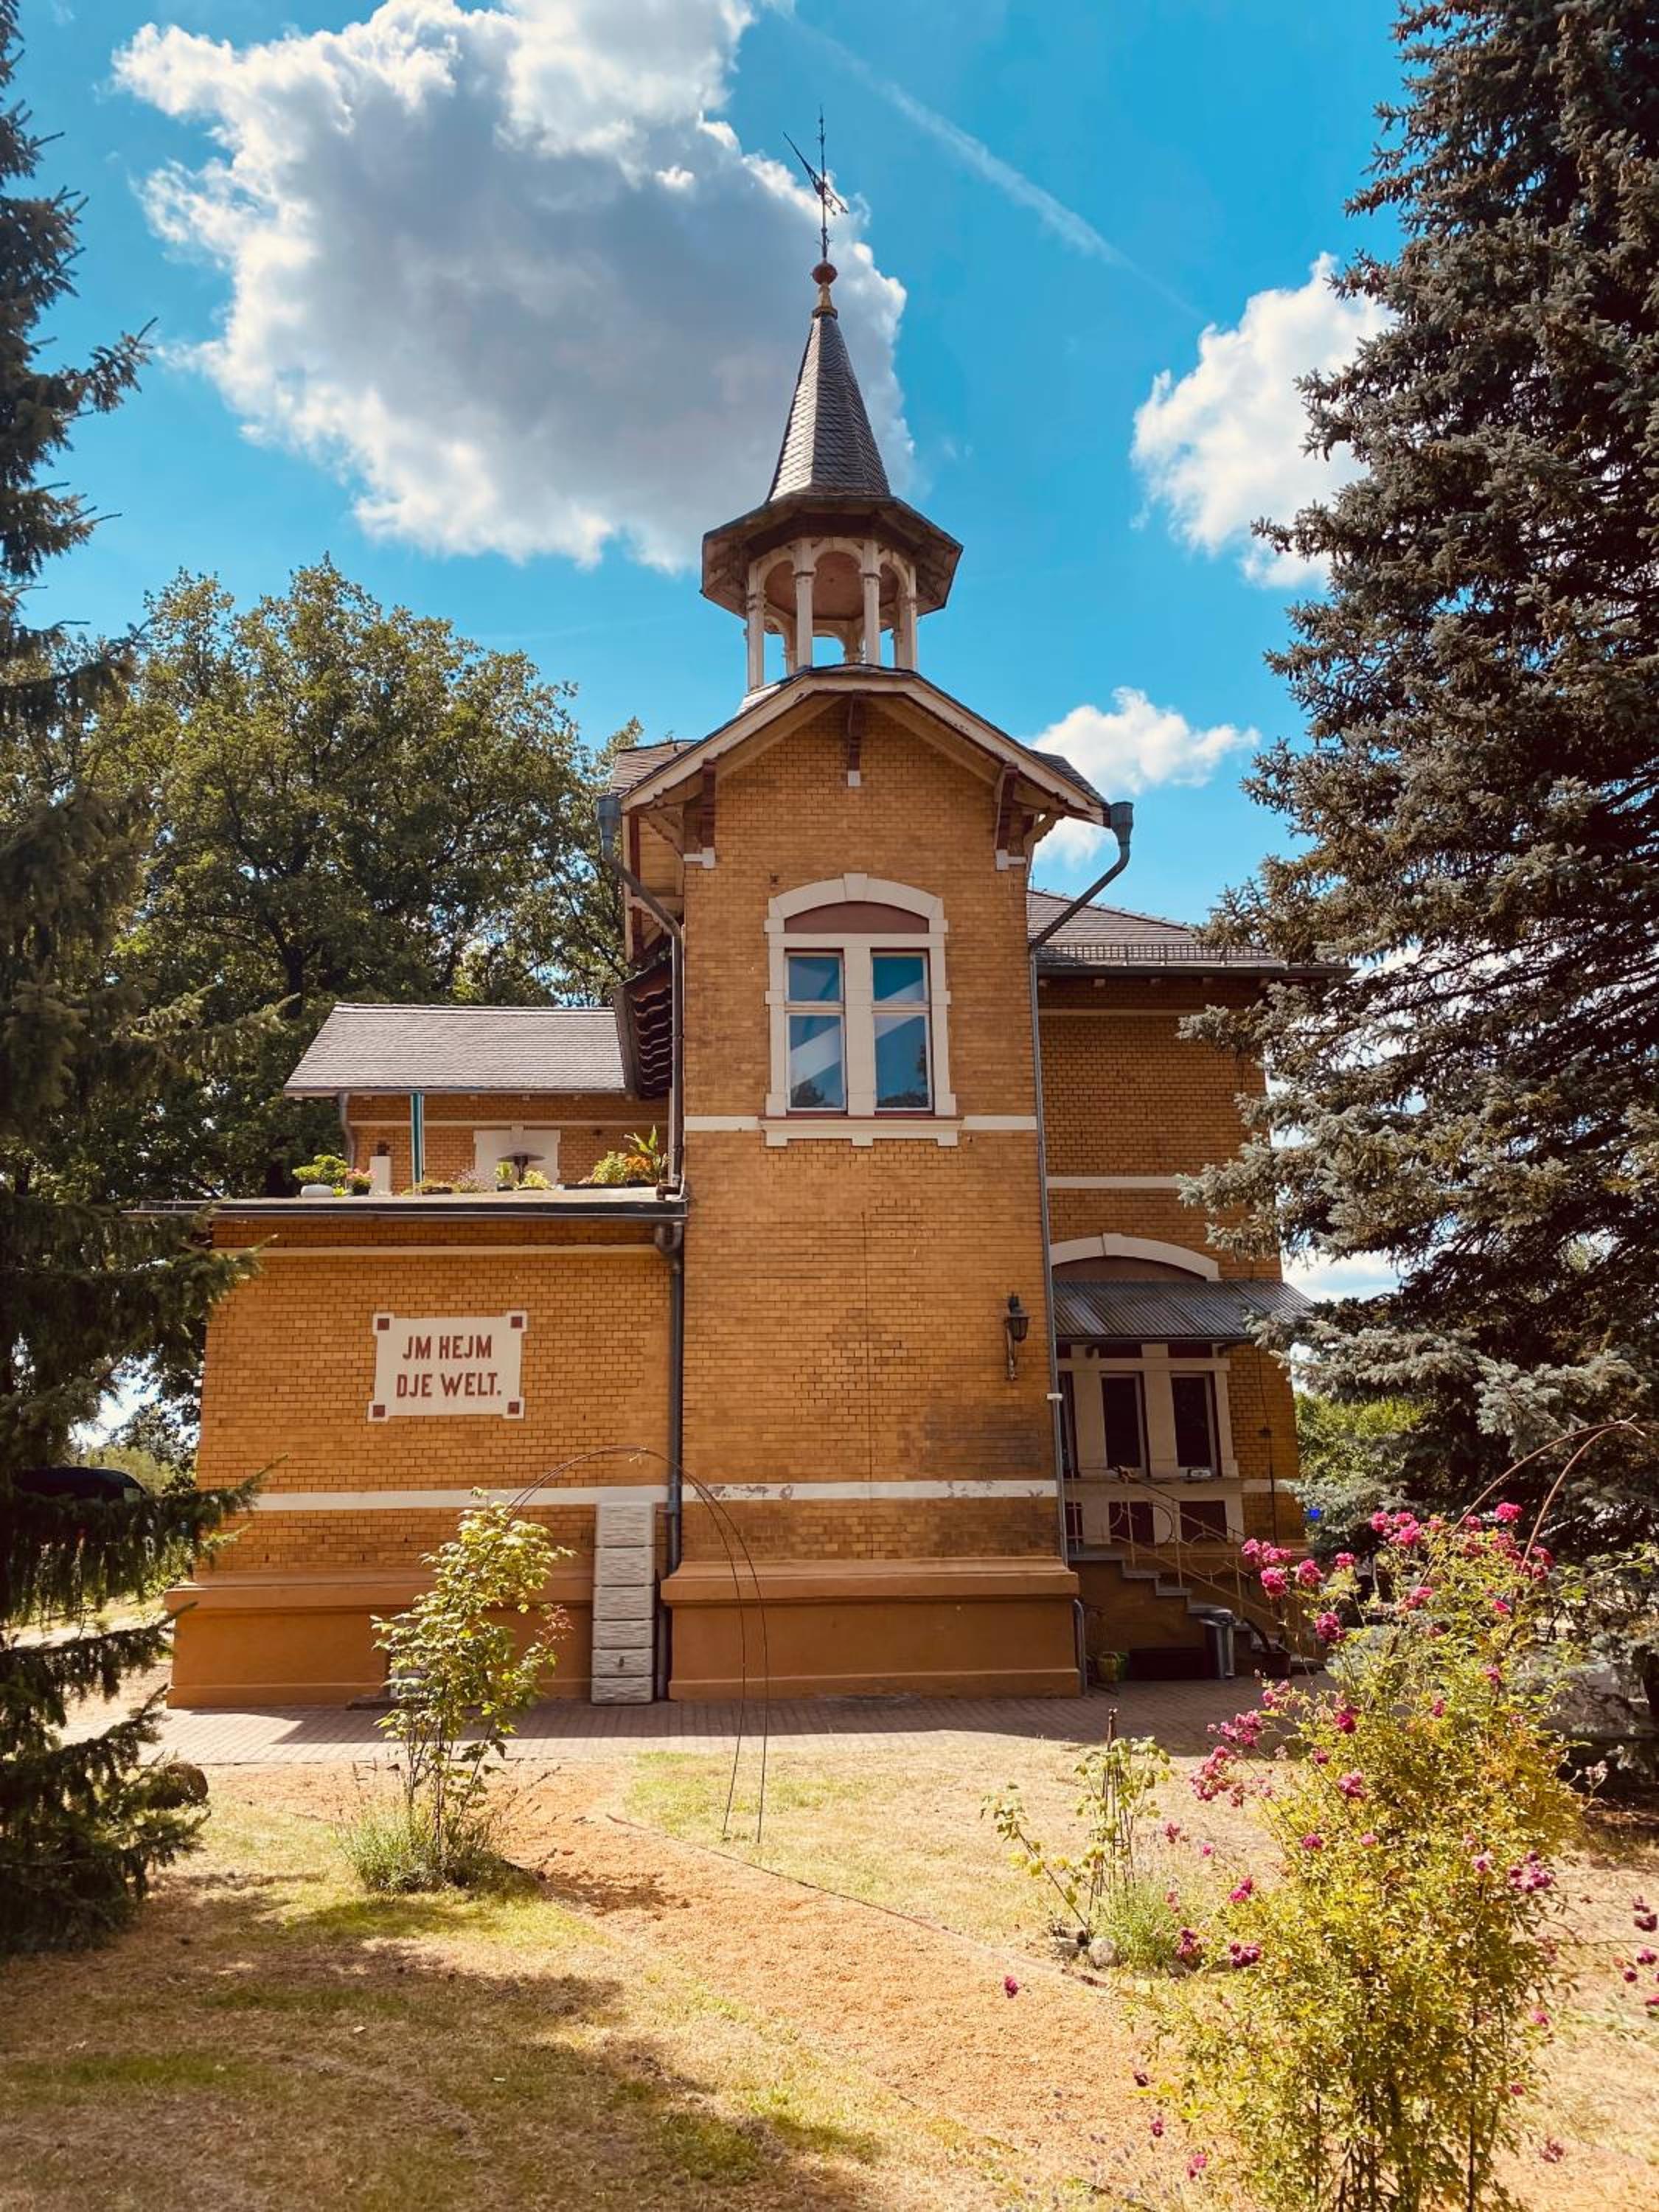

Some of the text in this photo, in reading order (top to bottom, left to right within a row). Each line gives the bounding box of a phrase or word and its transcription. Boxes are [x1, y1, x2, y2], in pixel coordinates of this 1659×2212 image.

[403, 1334, 493, 1360] JM HEJM
[396, 1372, 501, 1398] DJE WELT.
